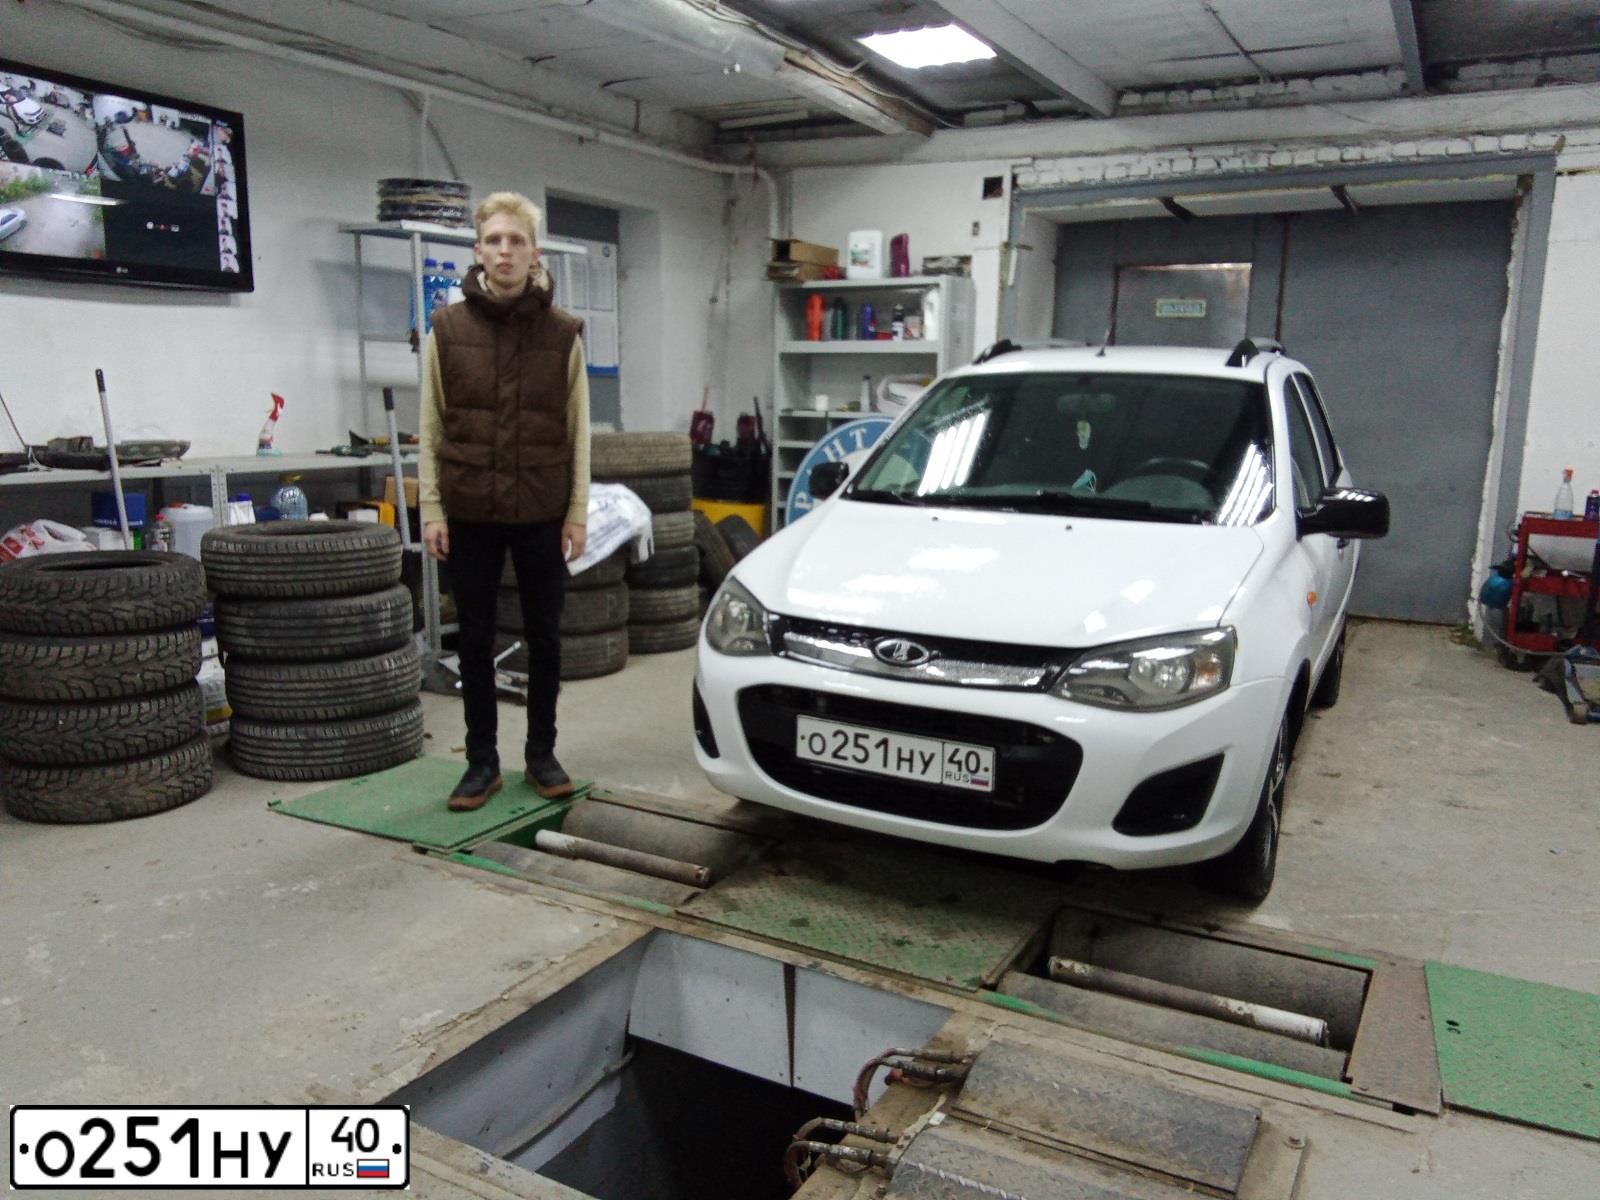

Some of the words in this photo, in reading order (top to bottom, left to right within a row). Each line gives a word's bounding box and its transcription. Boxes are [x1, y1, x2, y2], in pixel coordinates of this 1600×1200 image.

[808, 729, 936, 776] О251НУ
[947, 748, 981, 774] 40
[945, 771, 970, 783] RUS
